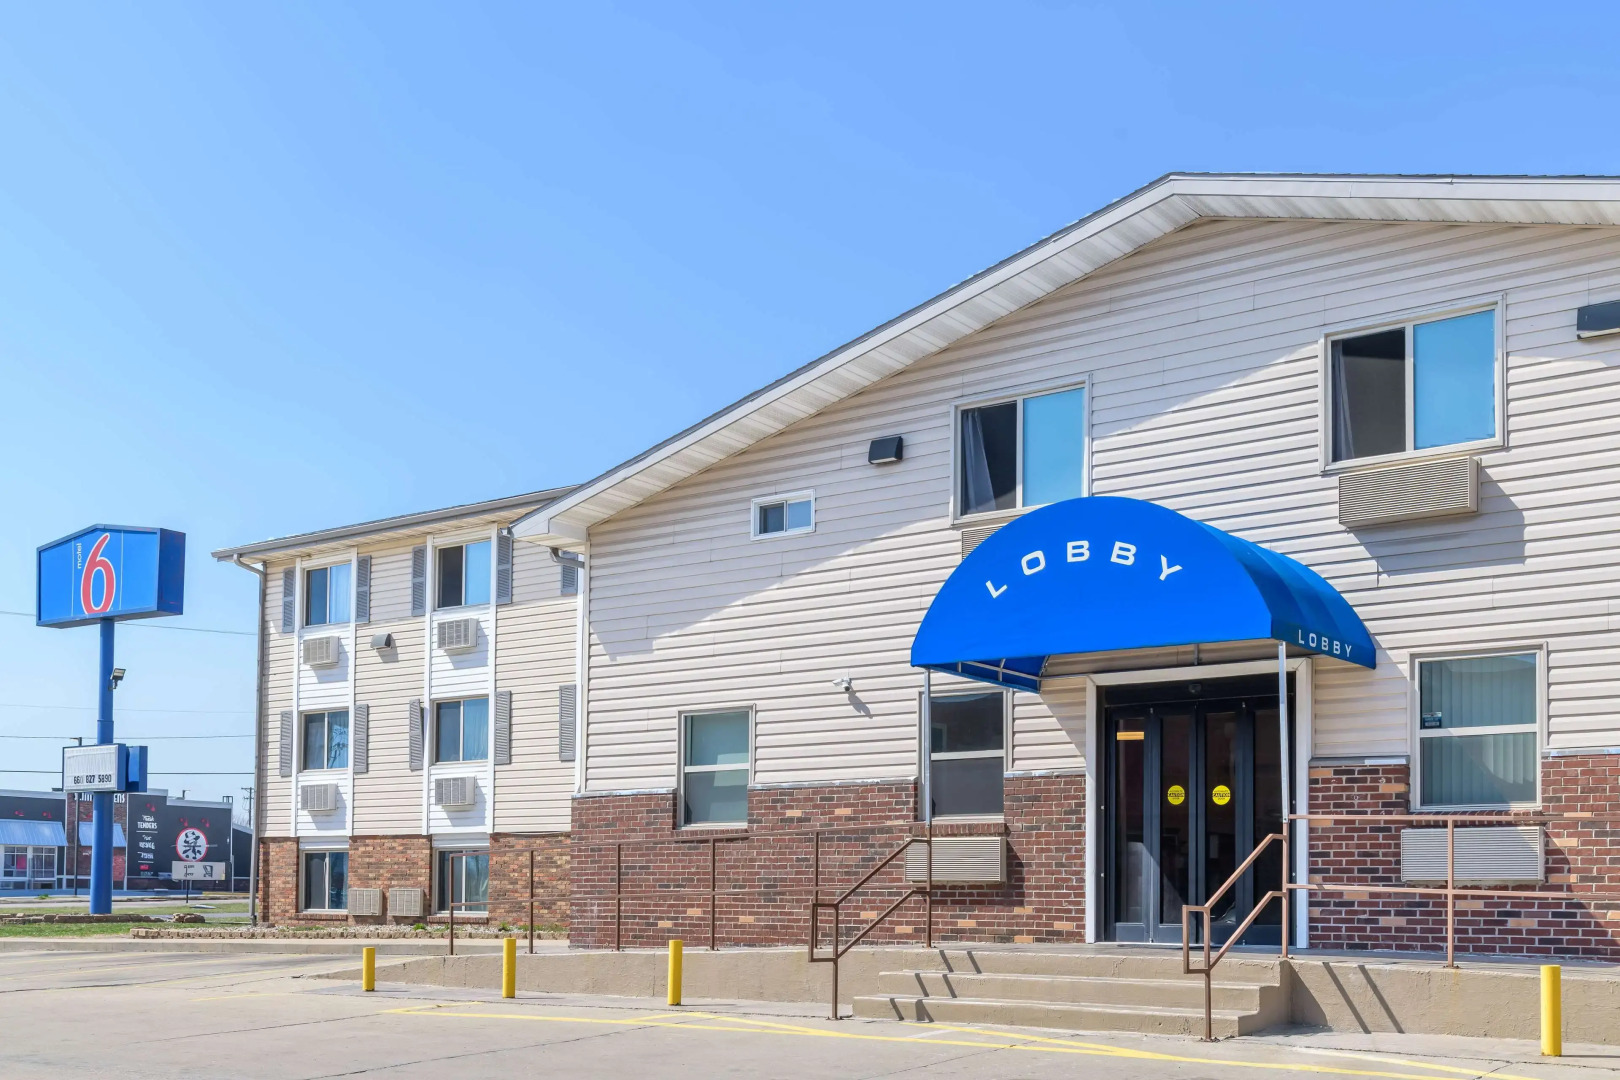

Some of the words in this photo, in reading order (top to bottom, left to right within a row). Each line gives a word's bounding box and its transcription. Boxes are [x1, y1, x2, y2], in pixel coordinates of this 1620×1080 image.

[81, 533, 116, 614] 6
[985, 540, 1183, 598] LOBBY
[1298, 629, 1353, 658] LOBBY
[85, 774, 96, 784] 827
